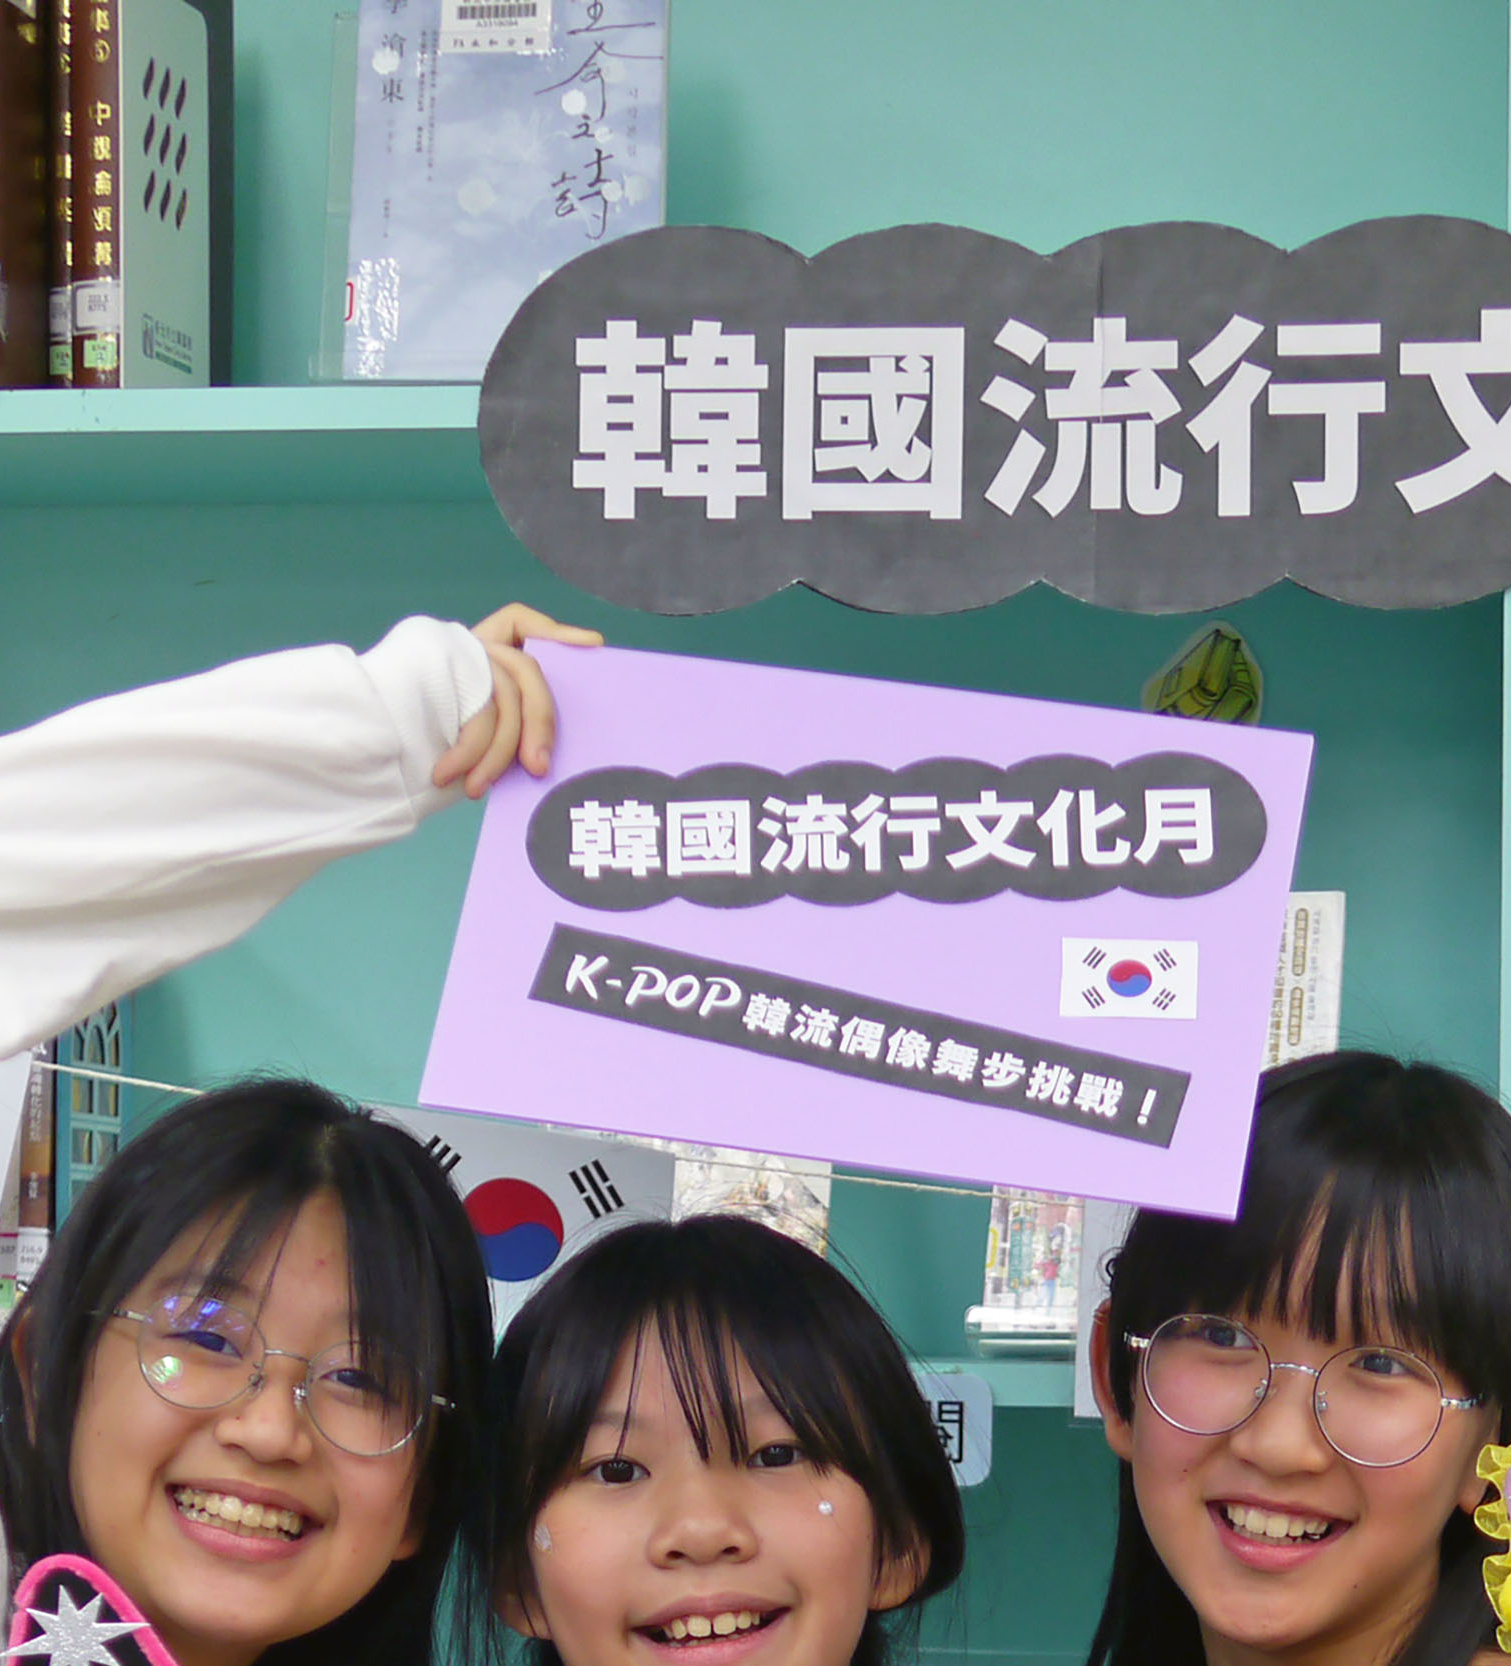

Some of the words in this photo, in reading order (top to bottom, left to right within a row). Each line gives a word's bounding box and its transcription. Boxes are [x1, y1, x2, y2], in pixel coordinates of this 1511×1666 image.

[568, 787, 1217, 879] 韓國流行文化月
